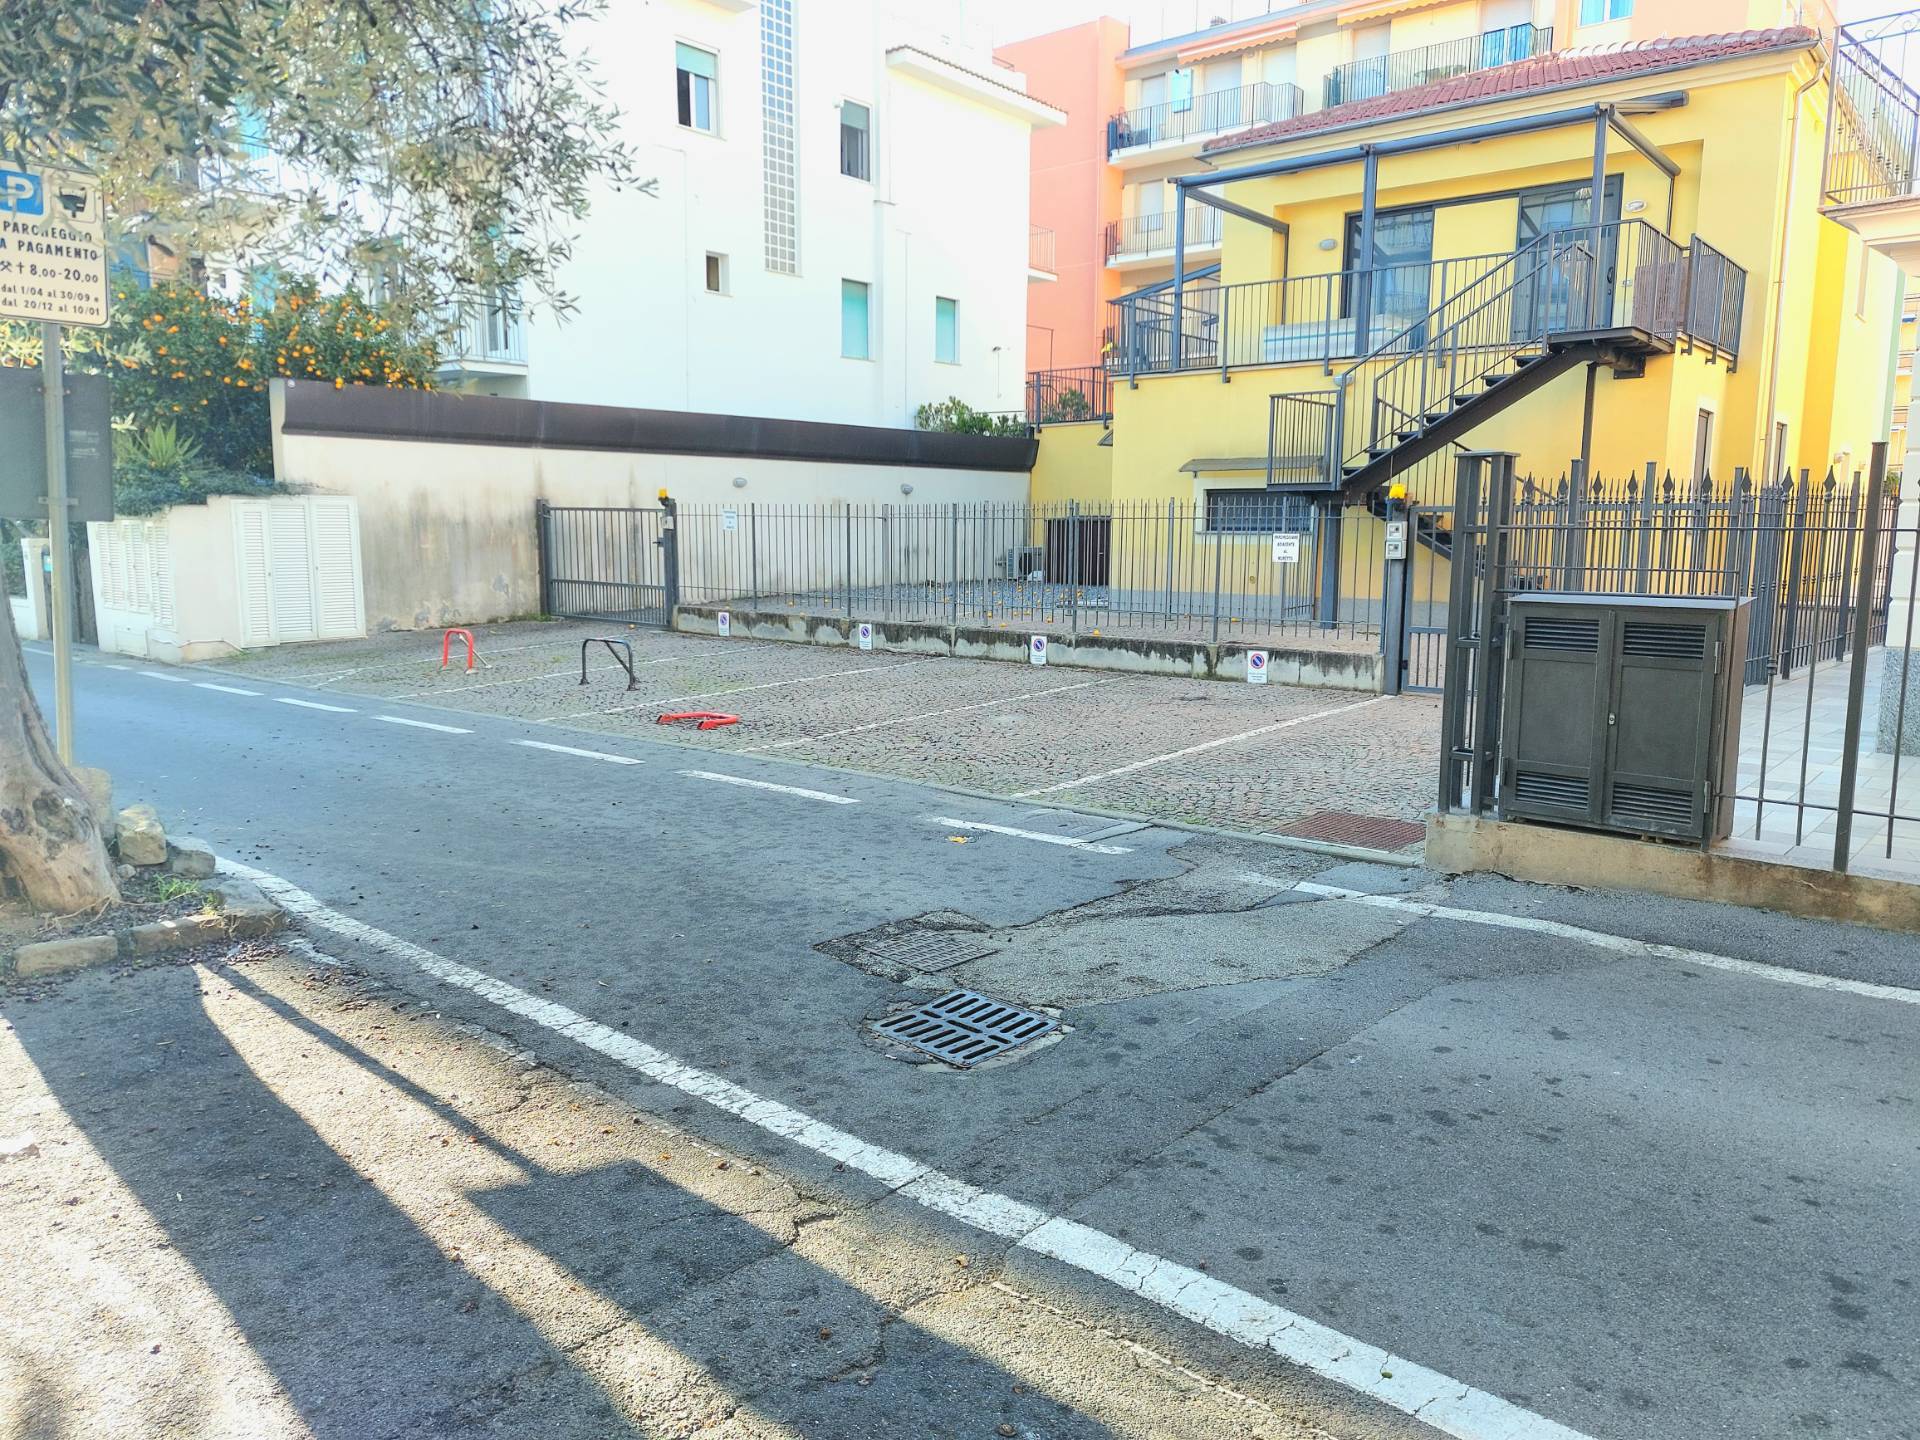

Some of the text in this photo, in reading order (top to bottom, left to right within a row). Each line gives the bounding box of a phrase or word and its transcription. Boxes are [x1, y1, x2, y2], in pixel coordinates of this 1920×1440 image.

[6, 175, 34, 208] P
[0, 237, 97, 260] A PAGAMENTO
[1, 283, 16, 294] dal
[21, 286, 43, 296] 1/04
[47, 290, 56, 298] al
[60, 290, 90, 302] 30/09
[1, 297, 100, 316] dal 20/12 al 10/01
